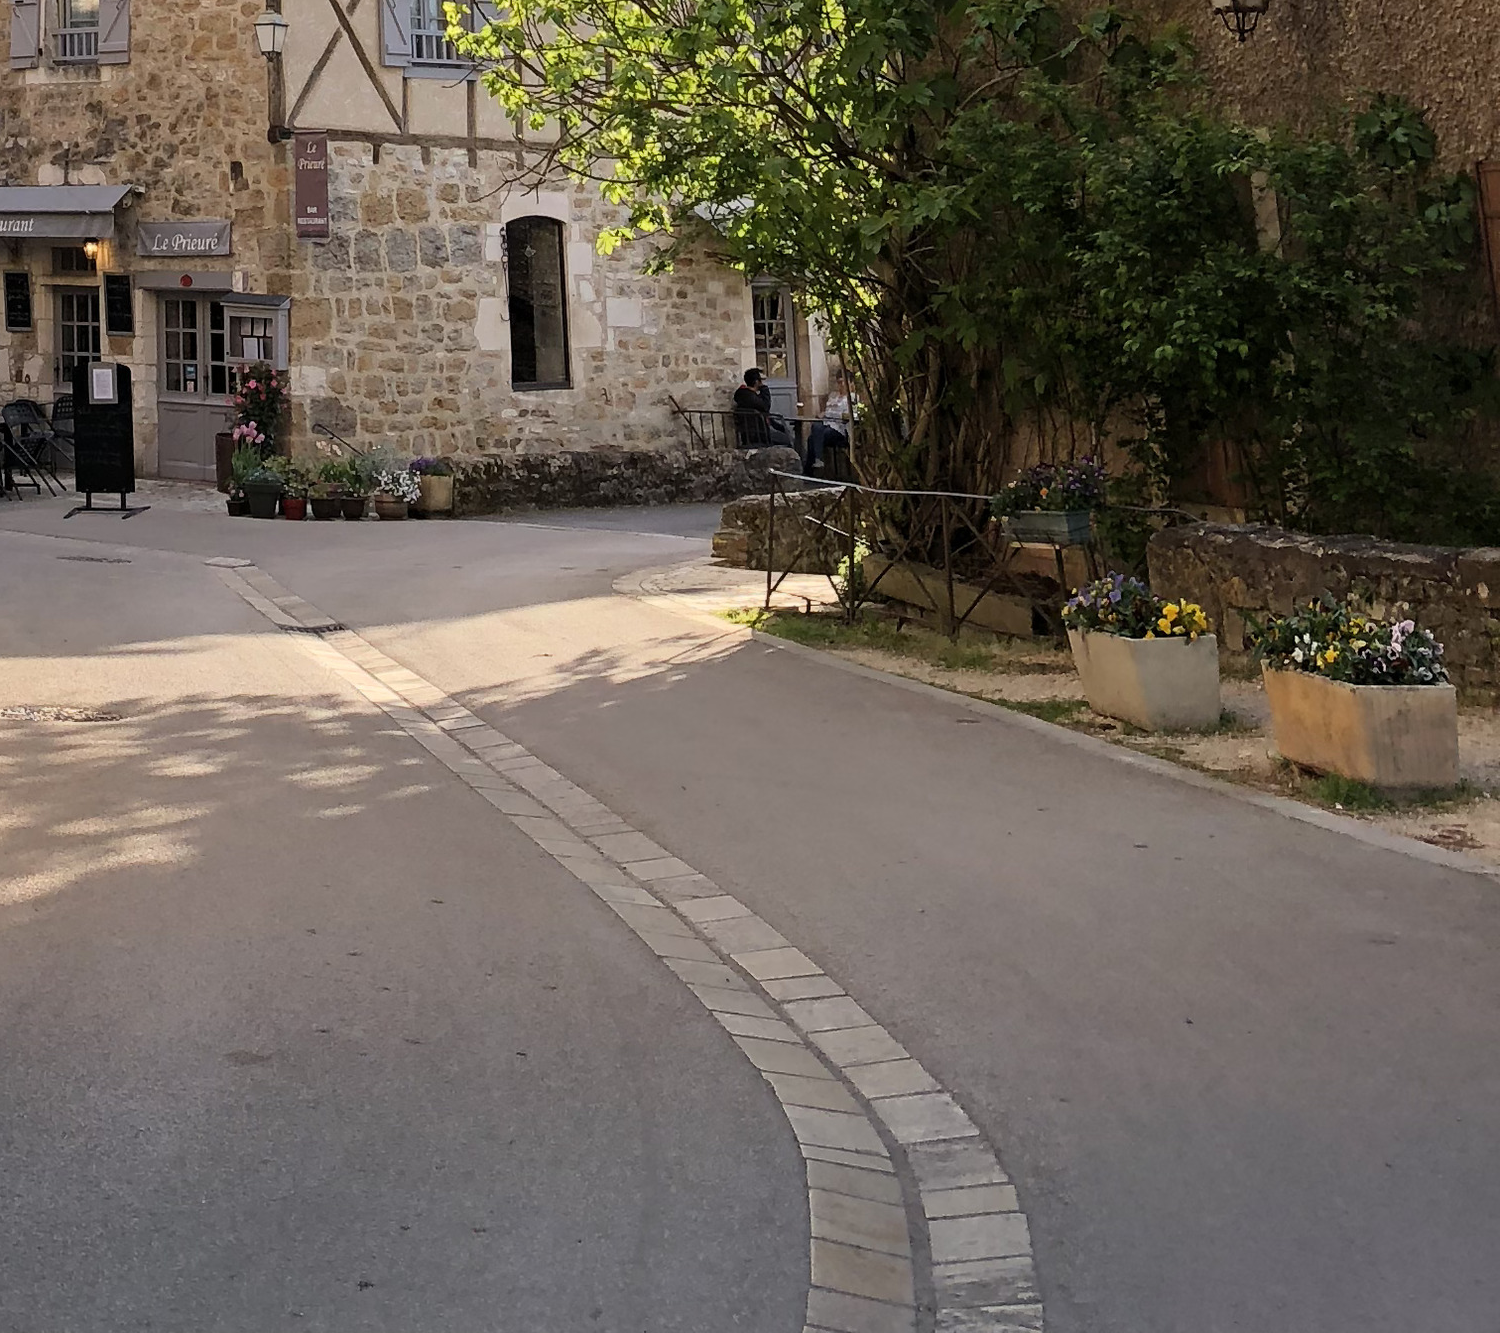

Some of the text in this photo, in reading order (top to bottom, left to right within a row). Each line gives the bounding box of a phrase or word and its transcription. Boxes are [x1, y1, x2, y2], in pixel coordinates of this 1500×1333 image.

[306, 141, 317, 154] Le
[151, 232, 218, 251] Le Prieuré
